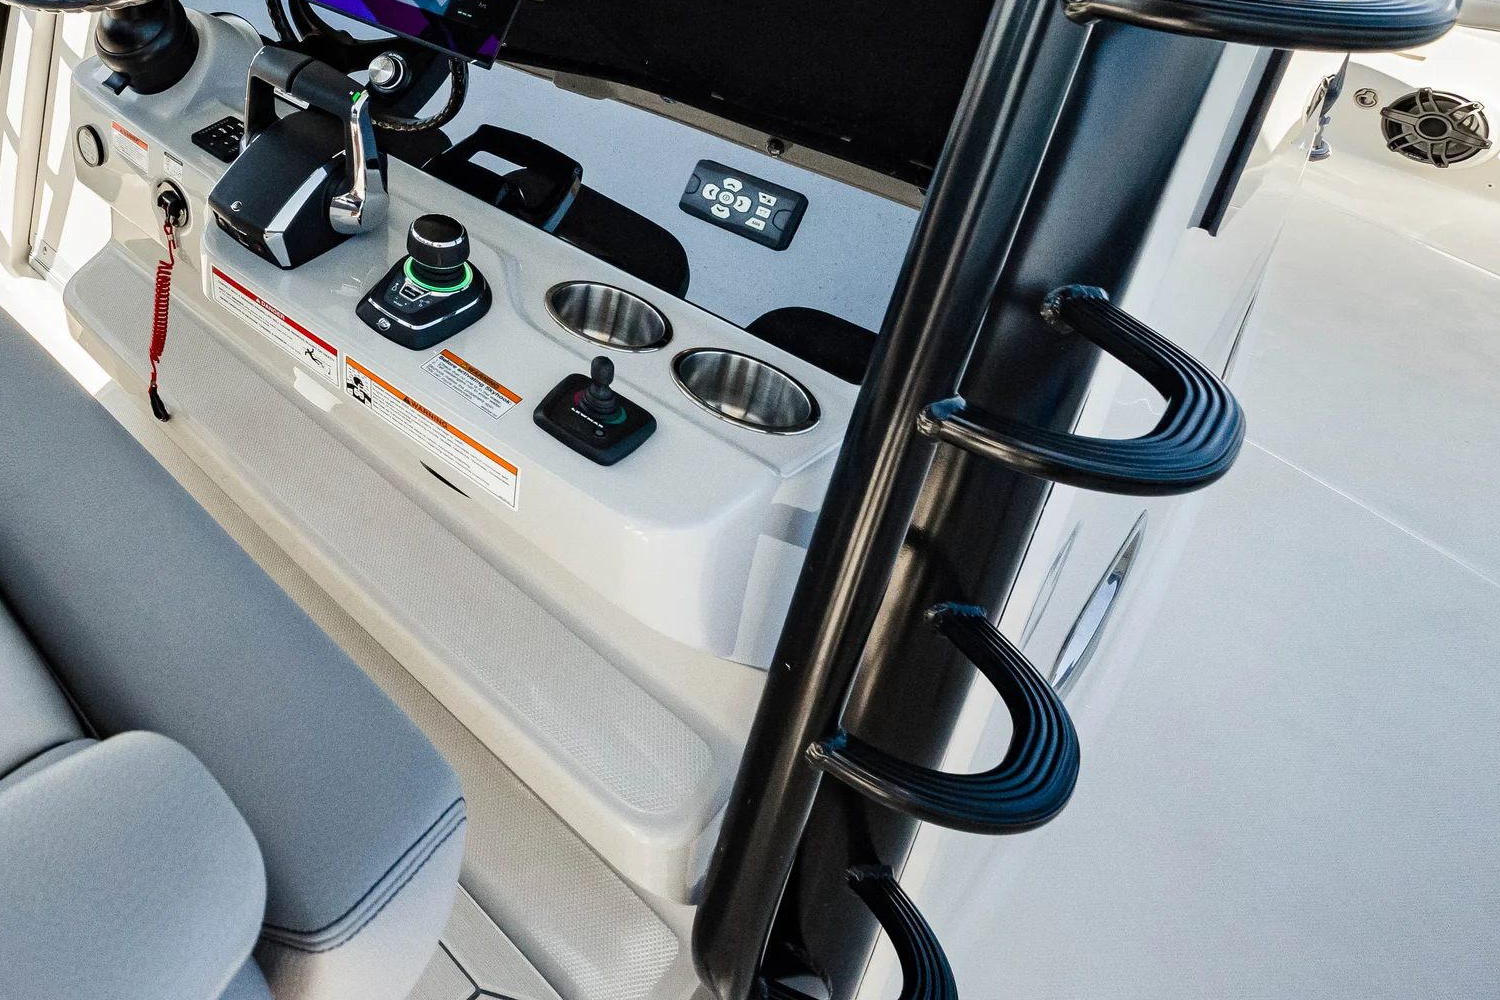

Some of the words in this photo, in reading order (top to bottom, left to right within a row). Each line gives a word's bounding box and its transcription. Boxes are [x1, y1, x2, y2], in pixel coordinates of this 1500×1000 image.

[261, 300, 284, 320] DANGER
[438, 355, 458, 368] Before
[456, 367, 485, 387] activating
[483, 385, 513, 405] Skyhook:
[466, 366, 500, 388] WARNING
[411, 400, 447, 429] WARNING
[571, 407, 604, 429] LEWMAR
